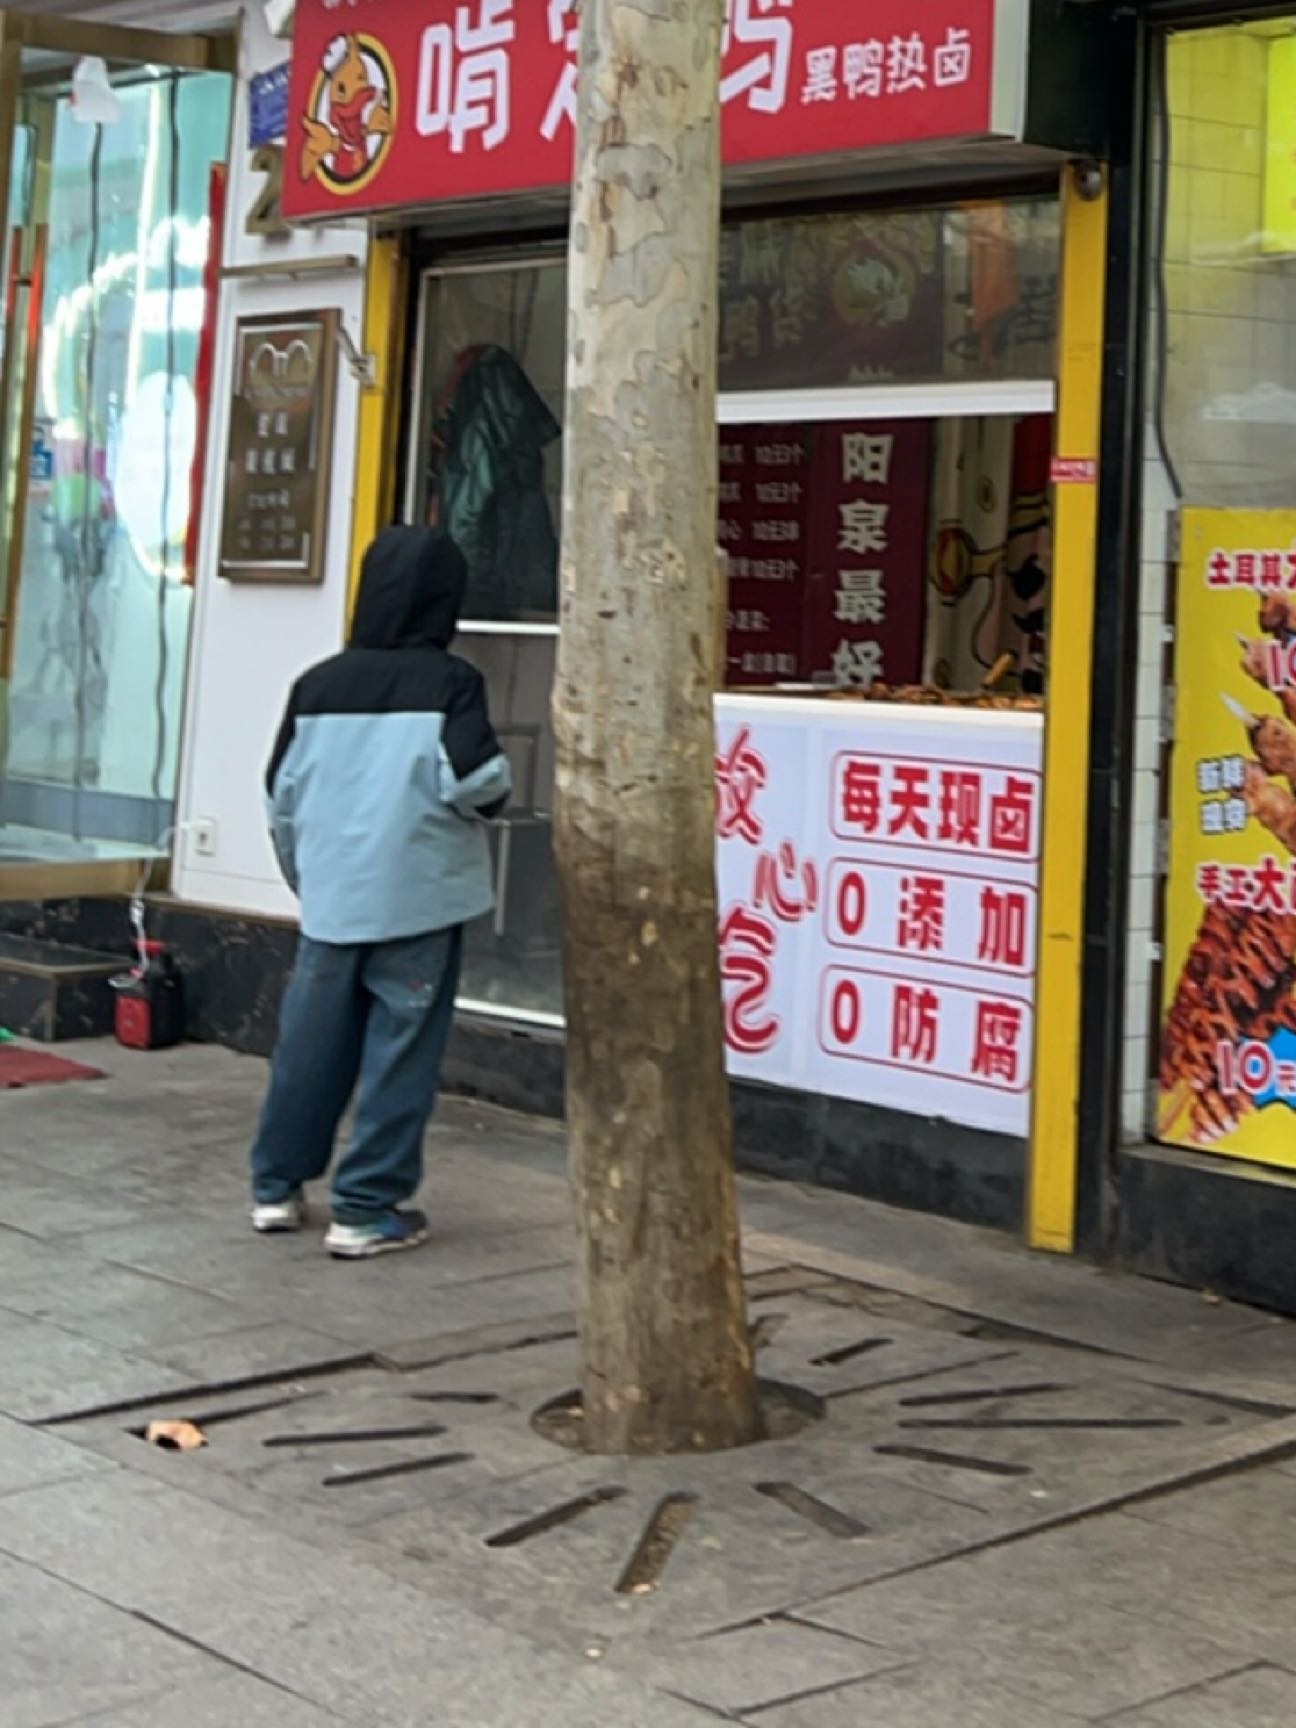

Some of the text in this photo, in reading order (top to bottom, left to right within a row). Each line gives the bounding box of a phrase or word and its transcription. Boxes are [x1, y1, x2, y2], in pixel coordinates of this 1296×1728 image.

[800, 28, 972, 105] 黑鸭热卤
[842, 760, 1034, 854] 每天现卤
